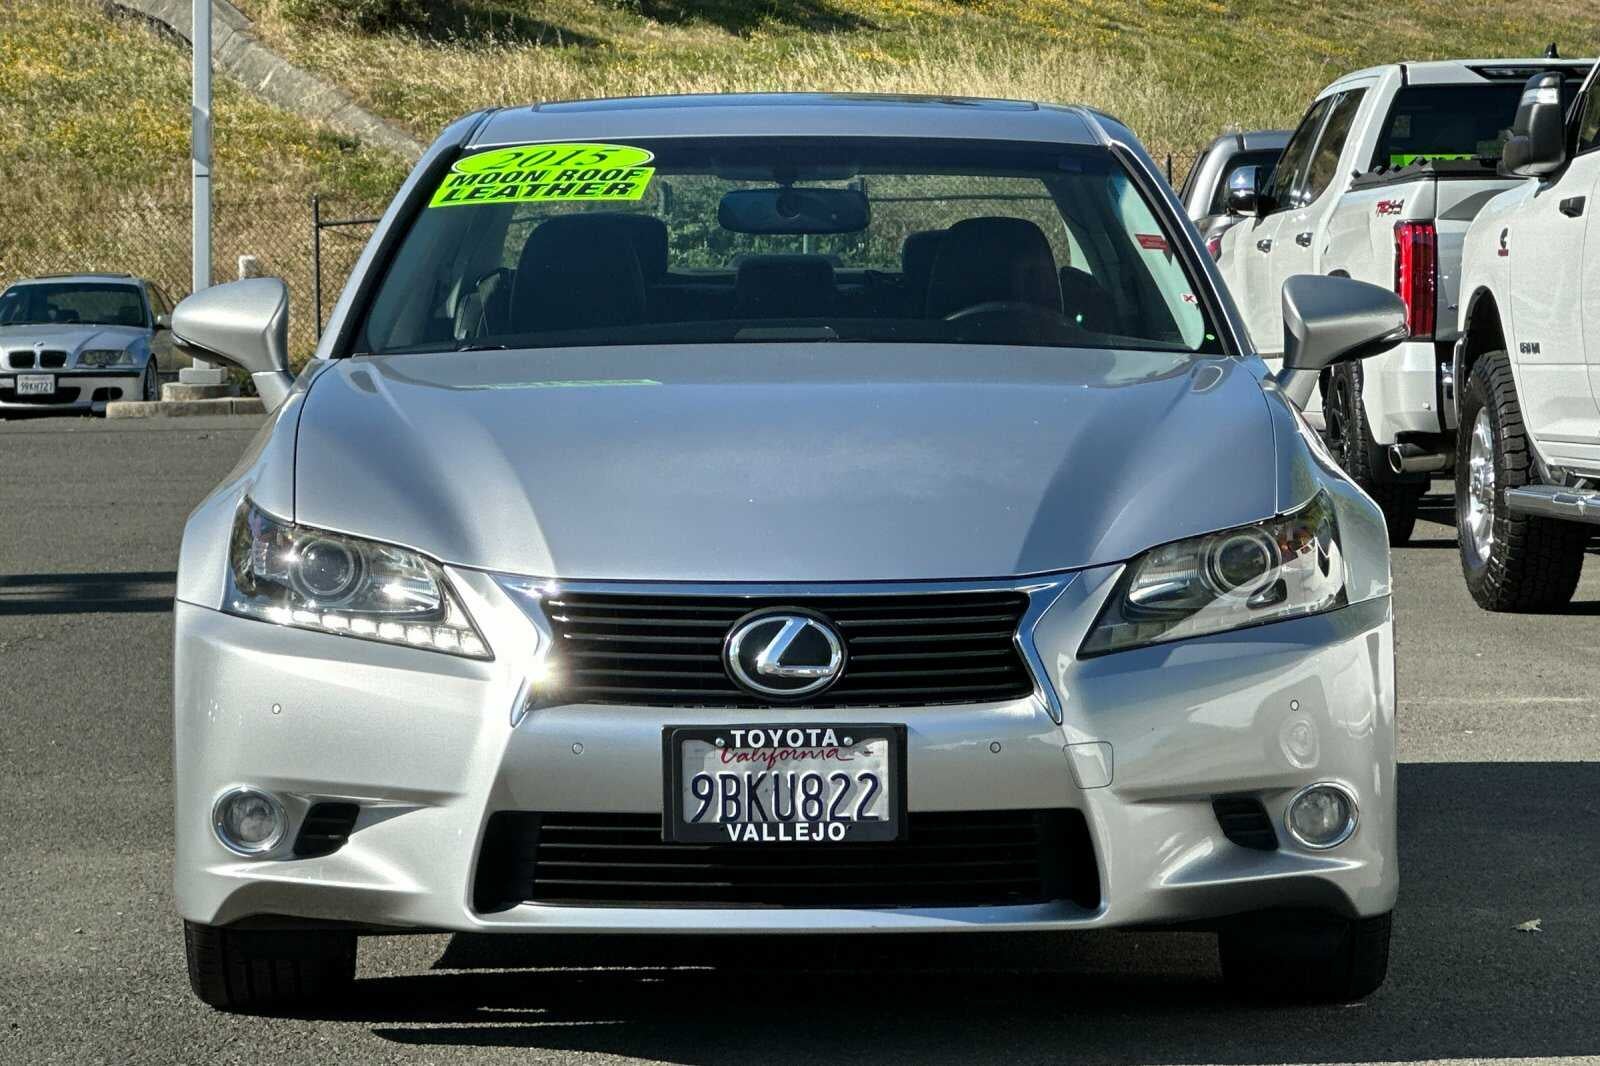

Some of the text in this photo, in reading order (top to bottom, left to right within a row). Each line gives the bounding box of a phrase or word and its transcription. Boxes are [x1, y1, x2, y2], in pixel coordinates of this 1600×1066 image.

[484, 149, 620, 170] 2015
[450, 169, 645, 187] MOON ROOF
[442, 182, 637, 202] LEATHER
[731, 729, 839, 748] TOYOTA
[721, 747, 853, 769] California
[691, 771, 880, 822] 9BKU822
[727, 823, 846, 841] VALLEJO
